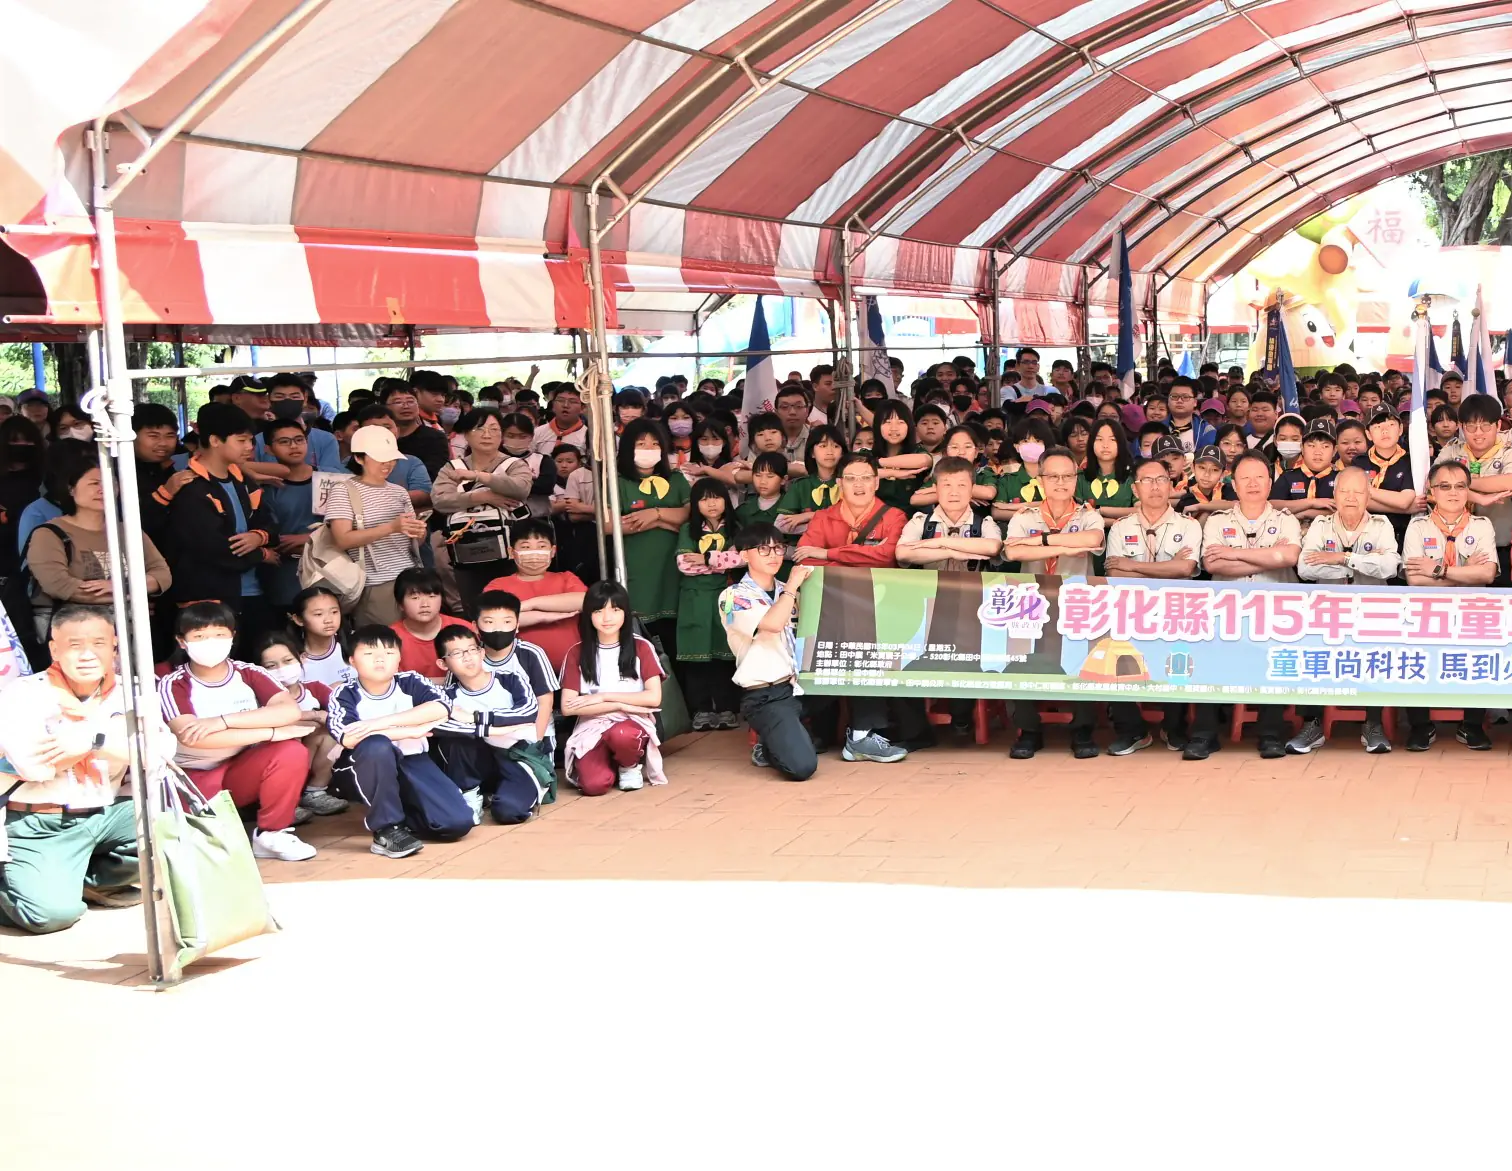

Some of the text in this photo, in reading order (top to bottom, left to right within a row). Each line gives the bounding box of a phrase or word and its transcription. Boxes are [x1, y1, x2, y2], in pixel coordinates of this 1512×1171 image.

[1365, 209, 1405, 245] 福
[1269, 648, 1427, 682] 童軍尚科技
